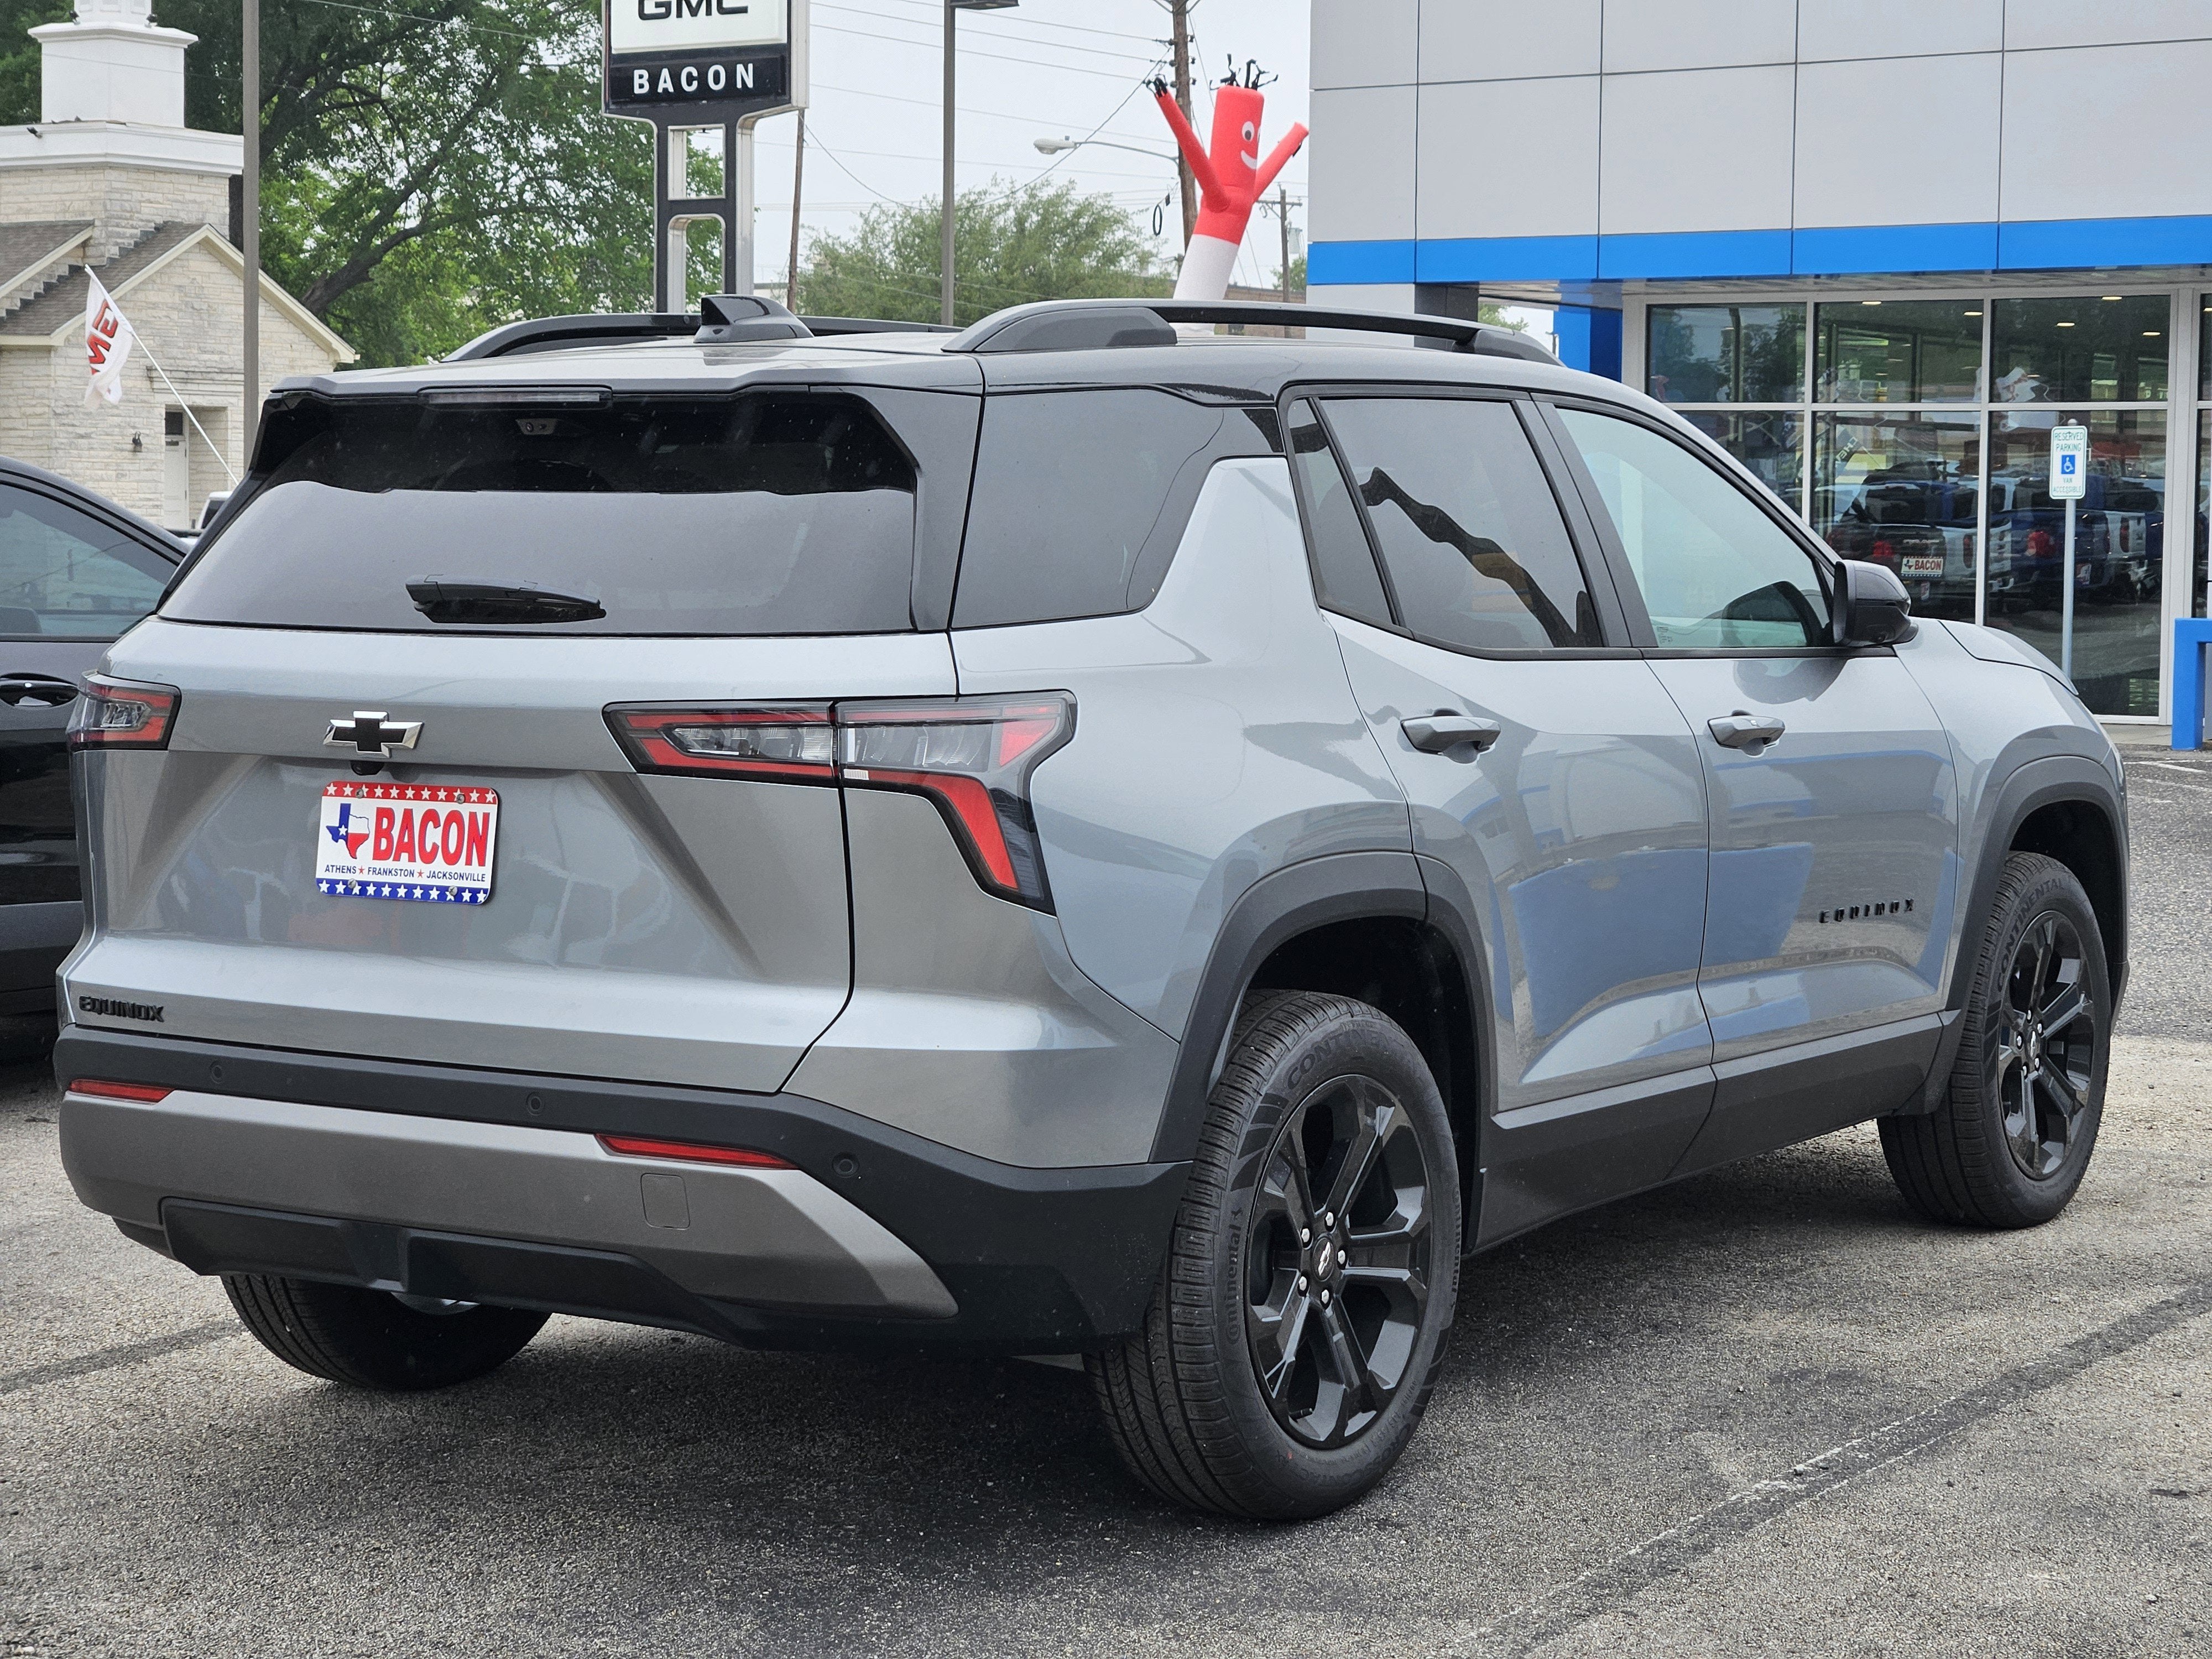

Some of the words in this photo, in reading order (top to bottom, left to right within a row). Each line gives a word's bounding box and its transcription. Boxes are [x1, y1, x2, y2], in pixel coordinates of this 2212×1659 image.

[638, 0, 748, 20] GMC
[633, 62, 753, 95] BACON
[2054, 432, 2084, 441] RESERVED
[2056, 444, 2081, 452] PARKING
[1914, 560, 1942, 571] BACON
[372, 806, 491, 867] BACON
[325, 864, 357, 874] ATHENS
[367, 867, 415, 878] FRANKSTON
[426, 870, 486, 882] JACKSONVILLE
[1819, 898, 1914, 924] EQUINOX
[1996, 878, 2064, 993] CONTINENTAL
[79, 996, 164, 1022] EQUINOX
